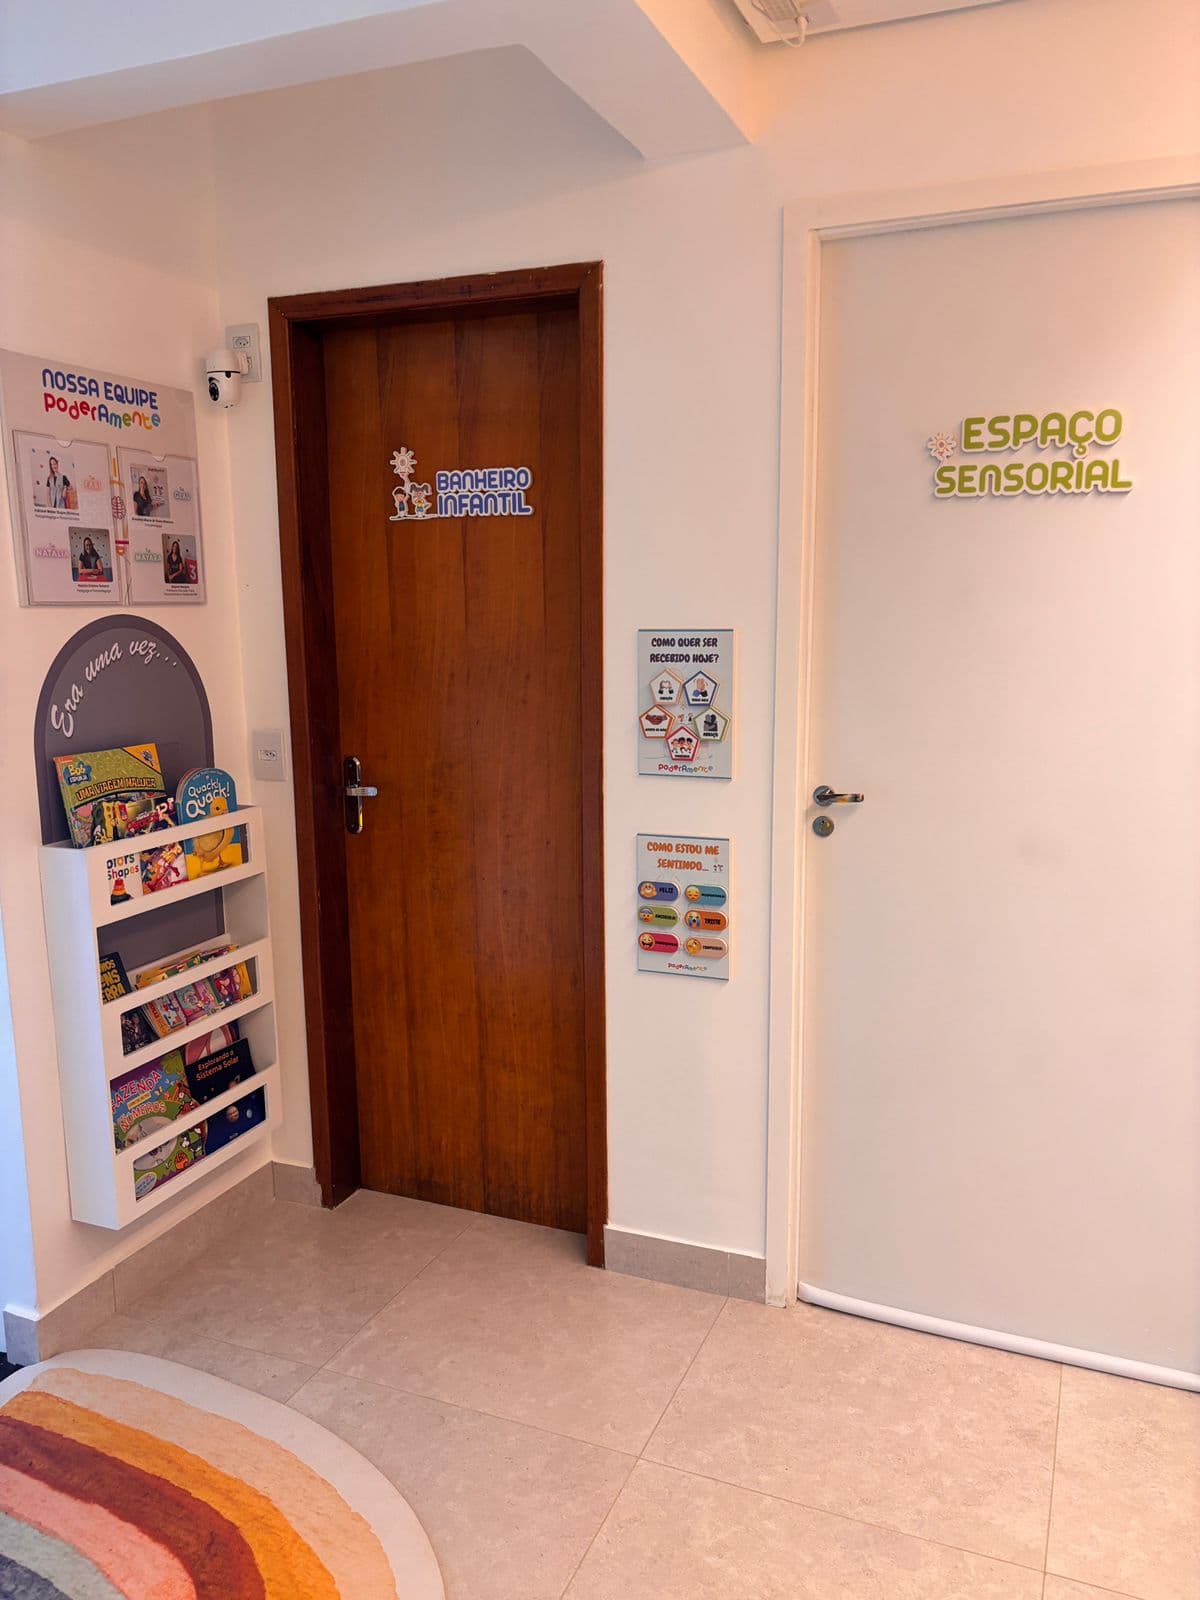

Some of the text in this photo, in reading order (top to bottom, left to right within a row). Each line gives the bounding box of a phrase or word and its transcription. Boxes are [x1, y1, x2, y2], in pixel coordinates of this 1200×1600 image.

[42, 369, 158, 410] NOSSA EQUIPE
[963, 409, 1122, 455] ESPAÇO
[437, 468, 530, 491] BANHEIRO
[936, 459, 1133, 494] SENSORIAL
[438, 492, 531, 515] INFANTIL
[651, 638, 718, 647] COMO QUER SER
[650, 653, 719, 663] RECEBIDO HOJE?
[51, 684, 83, 738] Era
[85, 642, 122, 682] uma
[76, 786, 95, 801] UMA
[186, 781, 230, 818] Quack!
[647, 842, 719, 855] COMO ESTOU ME
